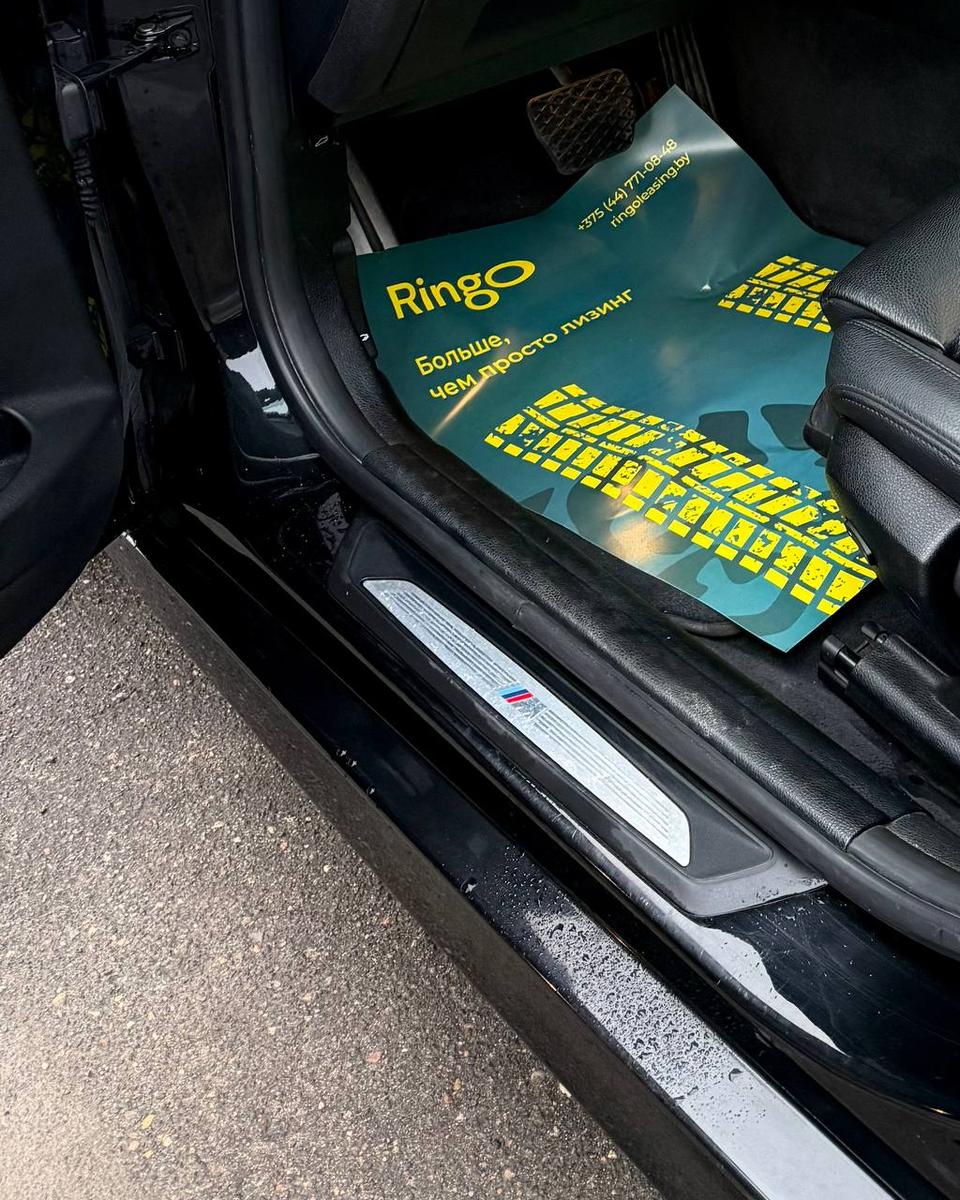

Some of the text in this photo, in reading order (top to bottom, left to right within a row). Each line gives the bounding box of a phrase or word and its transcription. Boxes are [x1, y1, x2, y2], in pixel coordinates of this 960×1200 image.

[578, 138, 678, 231] +375 (44) 771-08-48
[610, 152, 690, 228] ringoleasing.by
[386, 259, 536, 320] Ringo
[414, 332, 512, 377] Больше,
[429, 288, 634, 401] чем просто лизинг
